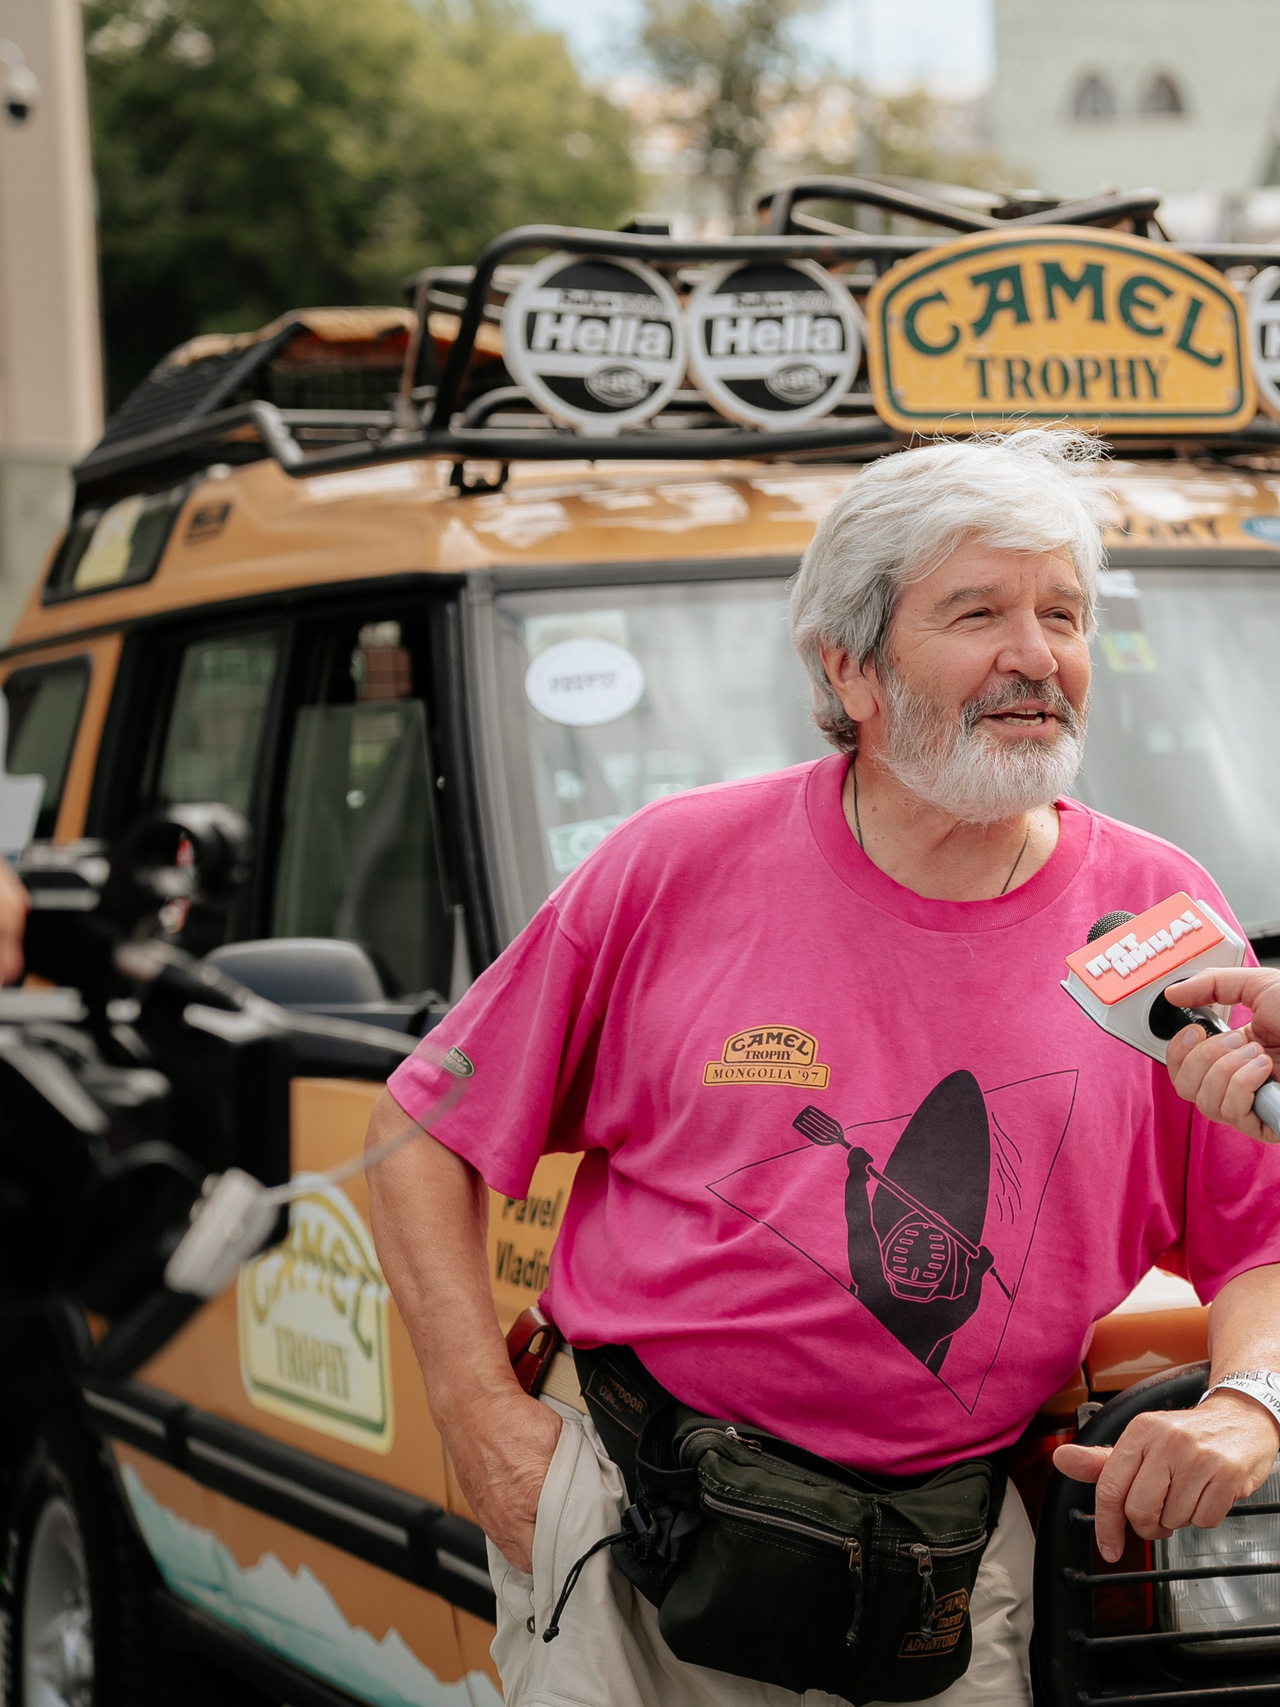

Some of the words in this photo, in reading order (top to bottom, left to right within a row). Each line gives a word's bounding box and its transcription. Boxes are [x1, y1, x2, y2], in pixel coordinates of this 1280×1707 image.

[530, 312, 673, 359] Hella
[710, 313, 844, 357] Hella
[904, 261, 1223, 366] CAMEL
[966, 356, 1166, 400] TROPHY
[1085, 932, 1140, 979] ПЯТ
[1111, 909, 1203, 978] НИЦА!
[731, 1031, 810, 1057] CAMEL
[745, 1049, 793, 1061] TROPHY
[712, 1067, 793, 1080] MONGOLIA
[797, 1069, 819, 1083] '97
